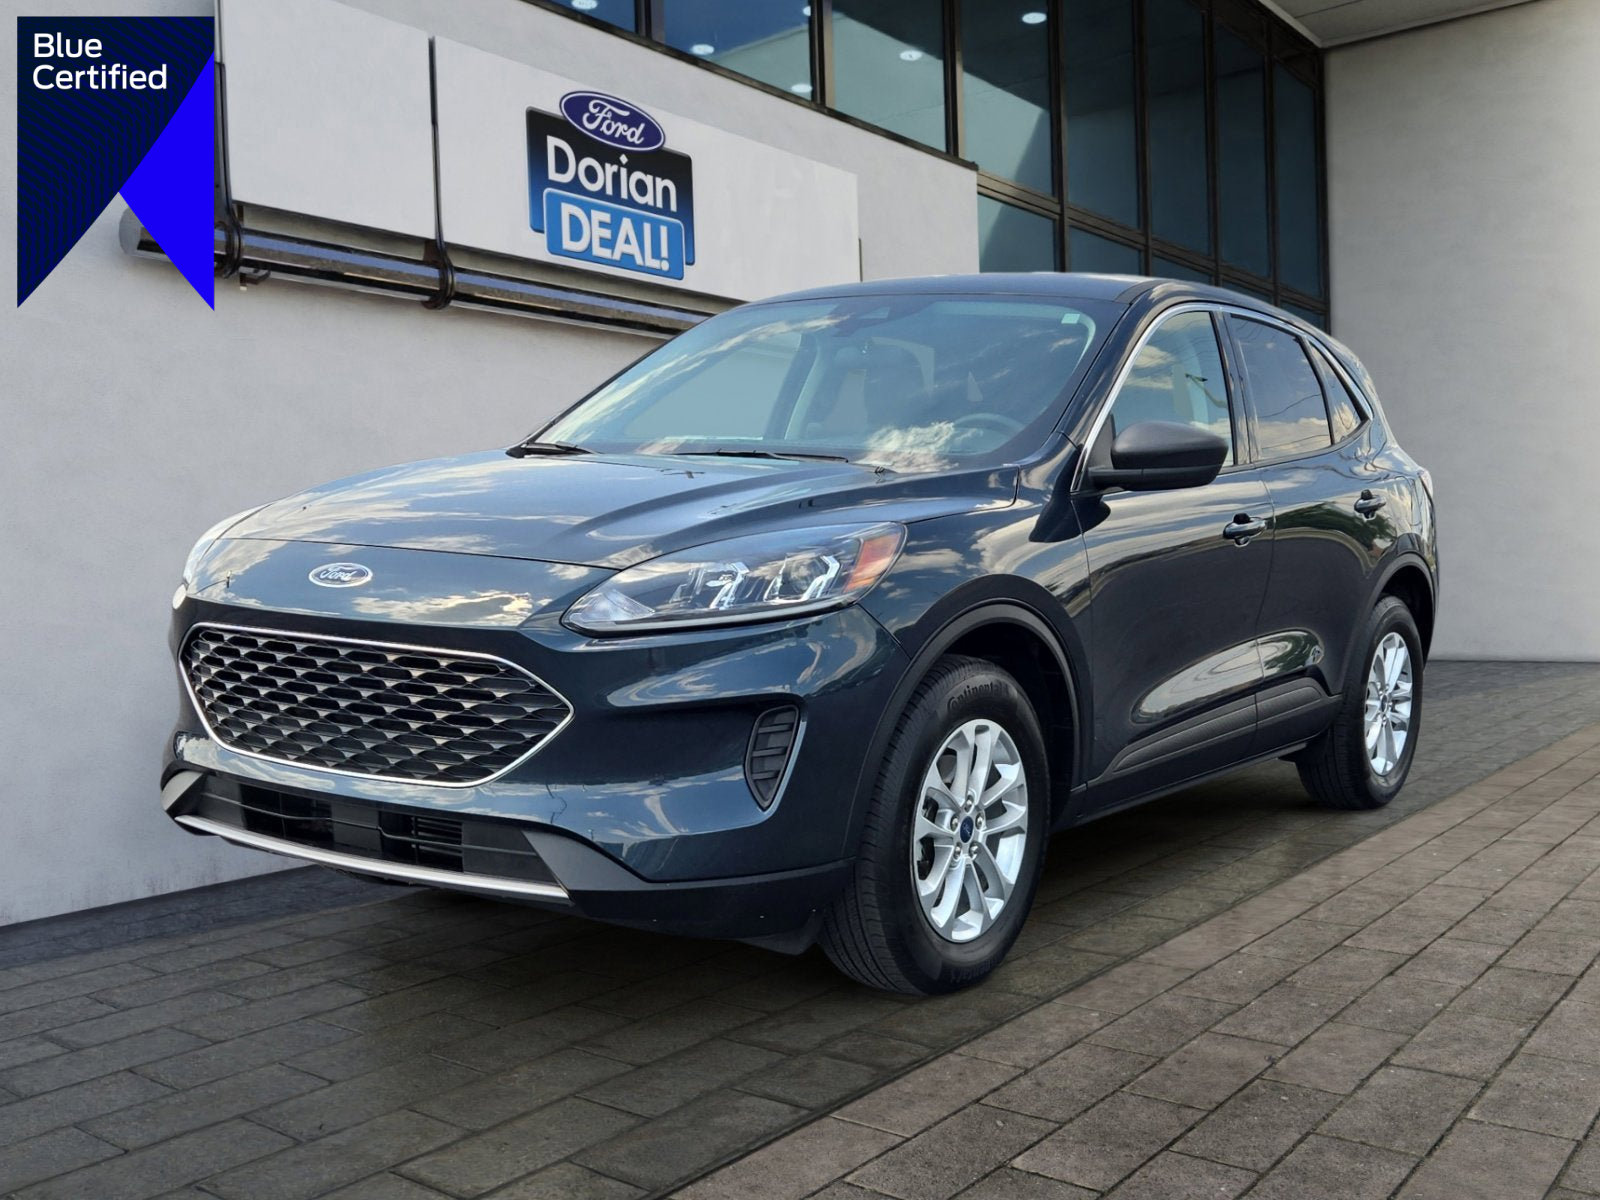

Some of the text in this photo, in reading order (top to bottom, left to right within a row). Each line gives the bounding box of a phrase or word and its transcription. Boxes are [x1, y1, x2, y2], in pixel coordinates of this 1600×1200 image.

[582, 99, 645, 144] Ford
[546, 134, 677, 212] Dorian
[560, 202, 670, 271] DEAL!
[319, 566, 357, 581] Ford
